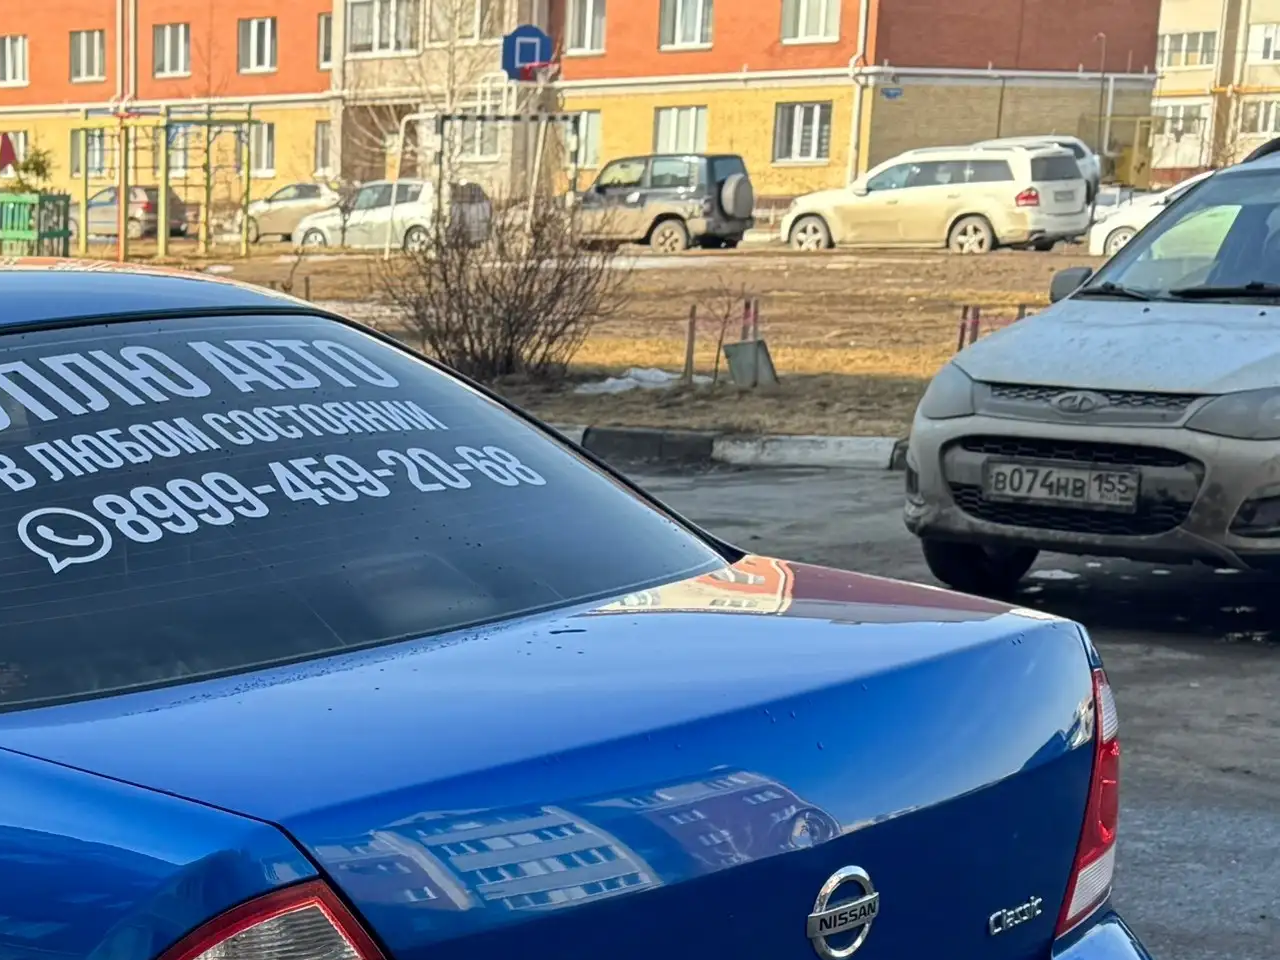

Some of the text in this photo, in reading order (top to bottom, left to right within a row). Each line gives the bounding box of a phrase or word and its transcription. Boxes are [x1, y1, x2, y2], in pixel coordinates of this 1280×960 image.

[188, 340, 399, 393] АВТО
[24, 417, 221, 482] ЛЮБОМ
[202, 400, 449, 445] СОСТОЯНИИ
[92, 446, 547, 543] 8999-459-20-68
[819, 901, 877, 931] NISSAN
[989, 896, 1042, 936] Classic
